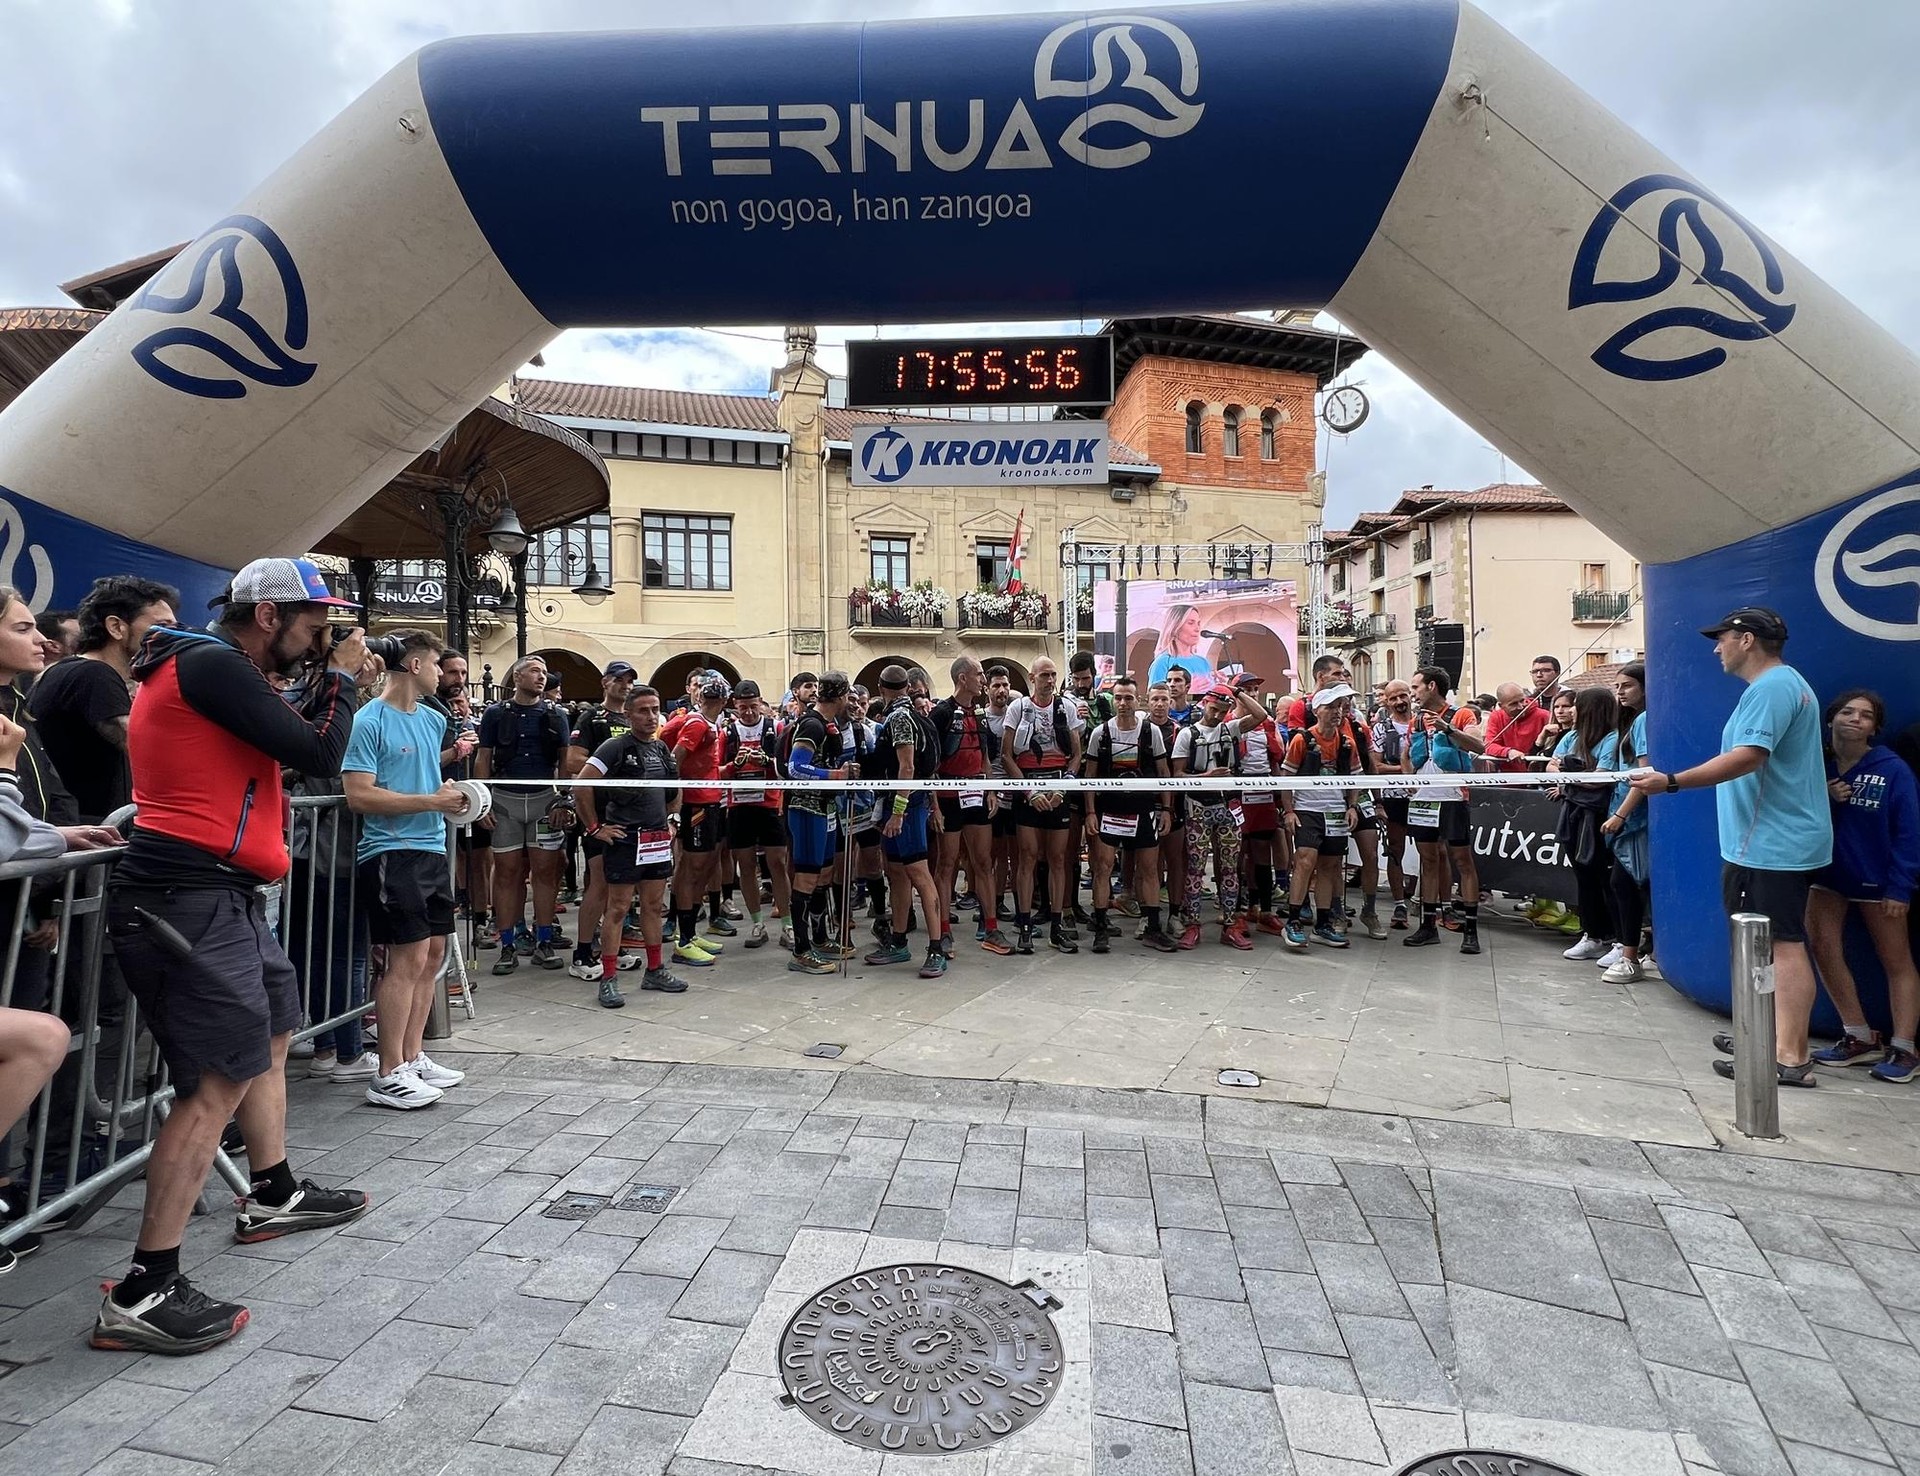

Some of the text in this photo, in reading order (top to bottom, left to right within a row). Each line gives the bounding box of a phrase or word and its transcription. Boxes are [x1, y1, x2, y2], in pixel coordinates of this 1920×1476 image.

[641, 97, 1053, 176] TERNUA
[671, 189, 1032, 231] non gogoa, han zangoa
[897, 350, 1080, 390] 17:55:56
[919, 438, 1102, 466] KRONOAK
[1001, 467, 1093, 478] kronoak.com
[352, 591, 420, 603] TRNUA
[1854, 774, 1886, 786] ATHL
[1850, 797, 1880, 808] DEPT
